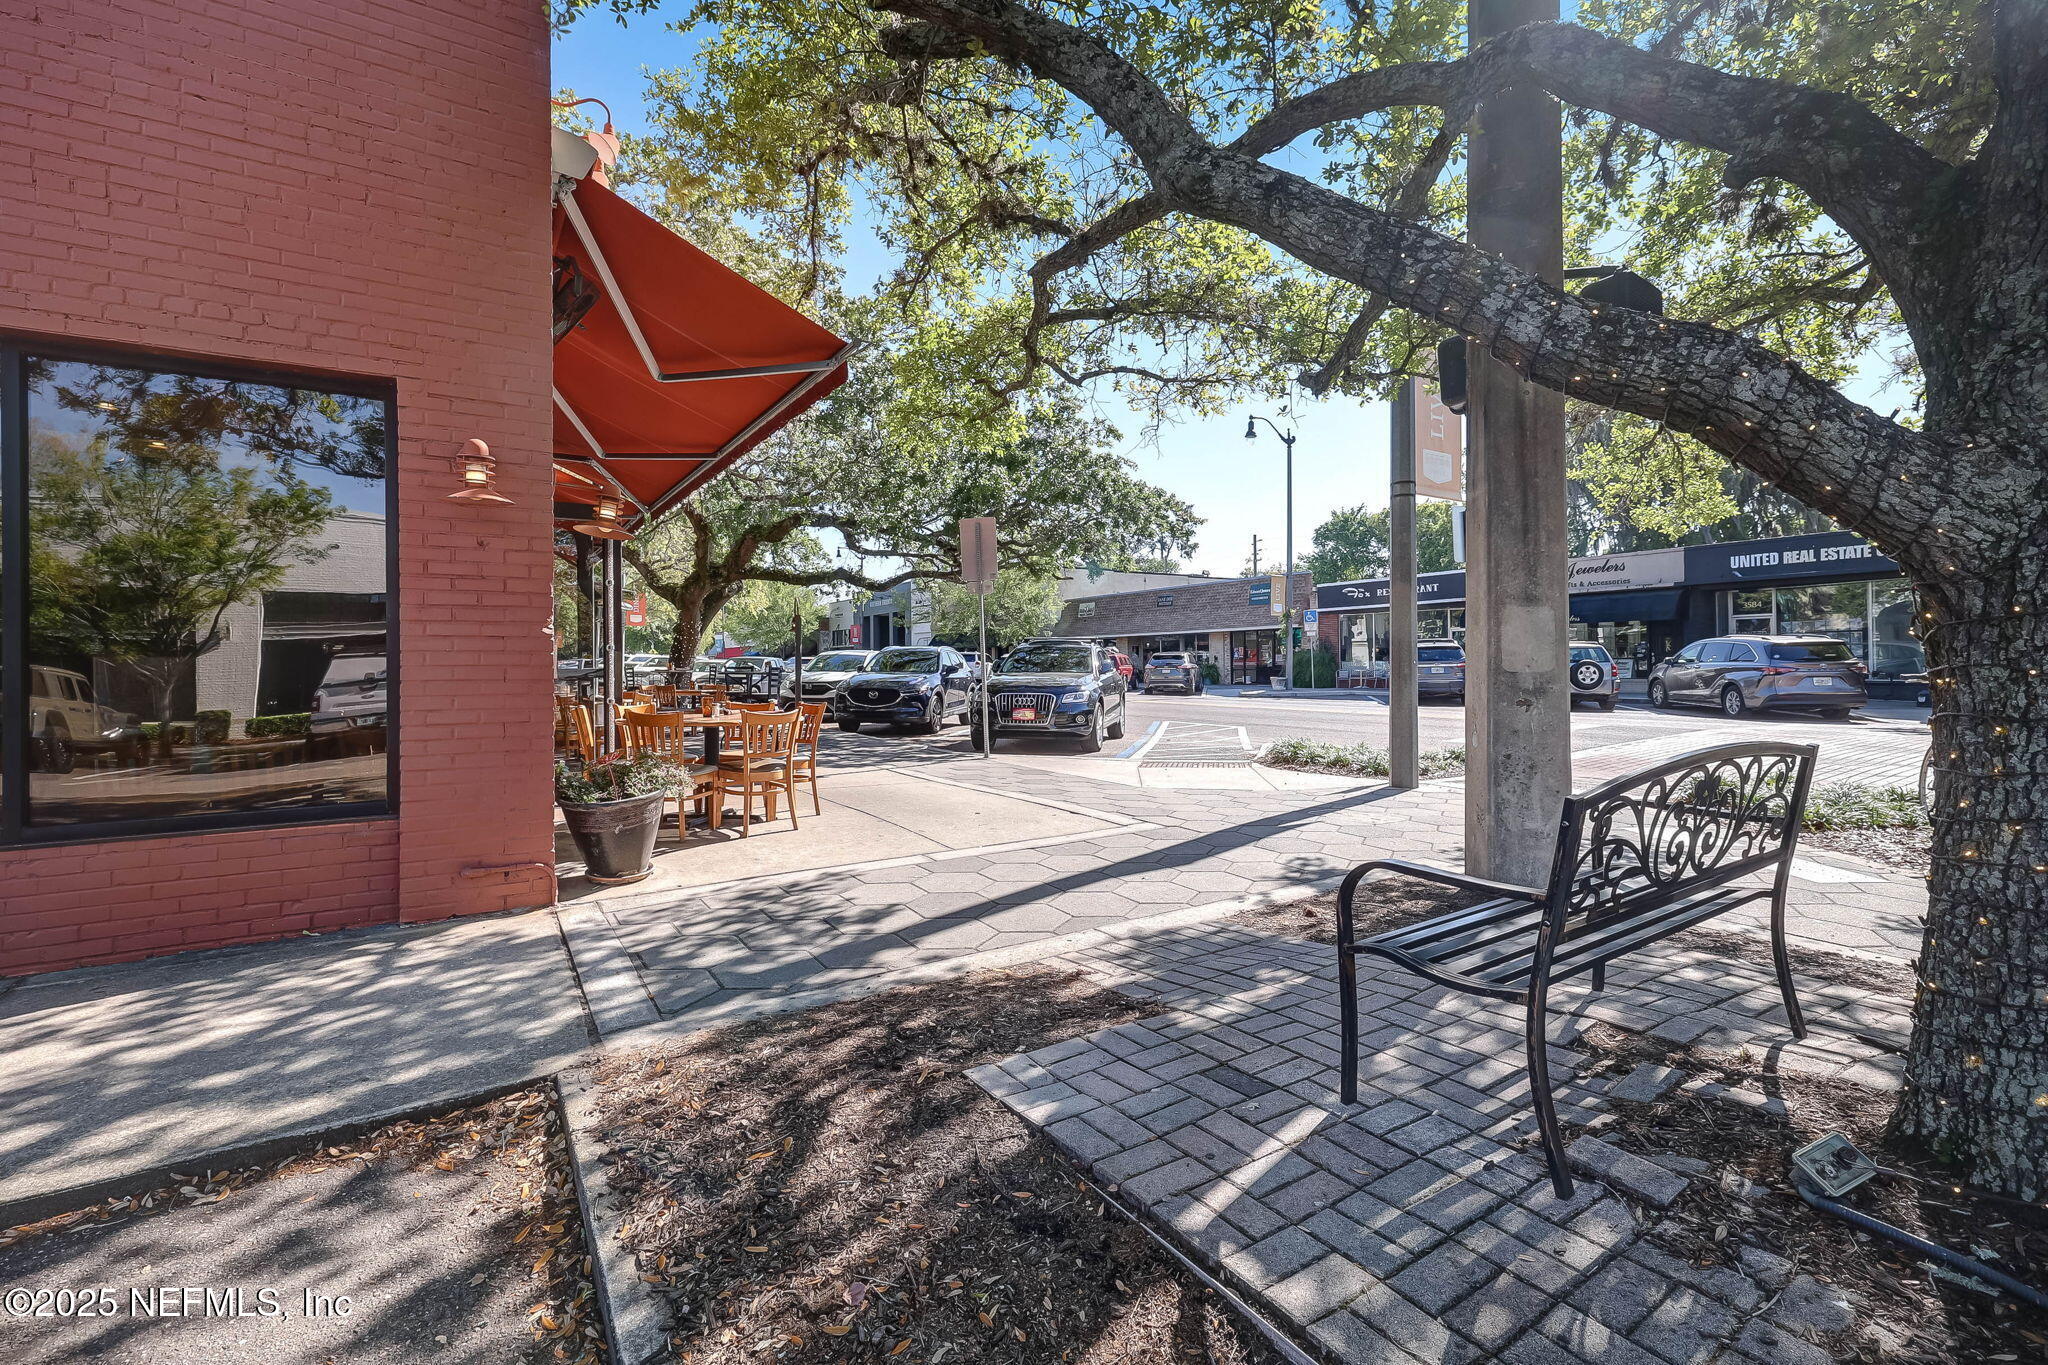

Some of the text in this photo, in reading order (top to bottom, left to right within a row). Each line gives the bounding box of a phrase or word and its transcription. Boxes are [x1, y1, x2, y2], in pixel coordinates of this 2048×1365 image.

[1430, 394, 1444, 441] LIV
[1730, 551, 1779, 569] UNITED
[1782, 548, 1816, 565] REAL
[1819, 544, 1872, 562] ESTATE
[1568, 558, 1626, 580] Jewelers
[1587, 578, 1631, 587] Accessories
